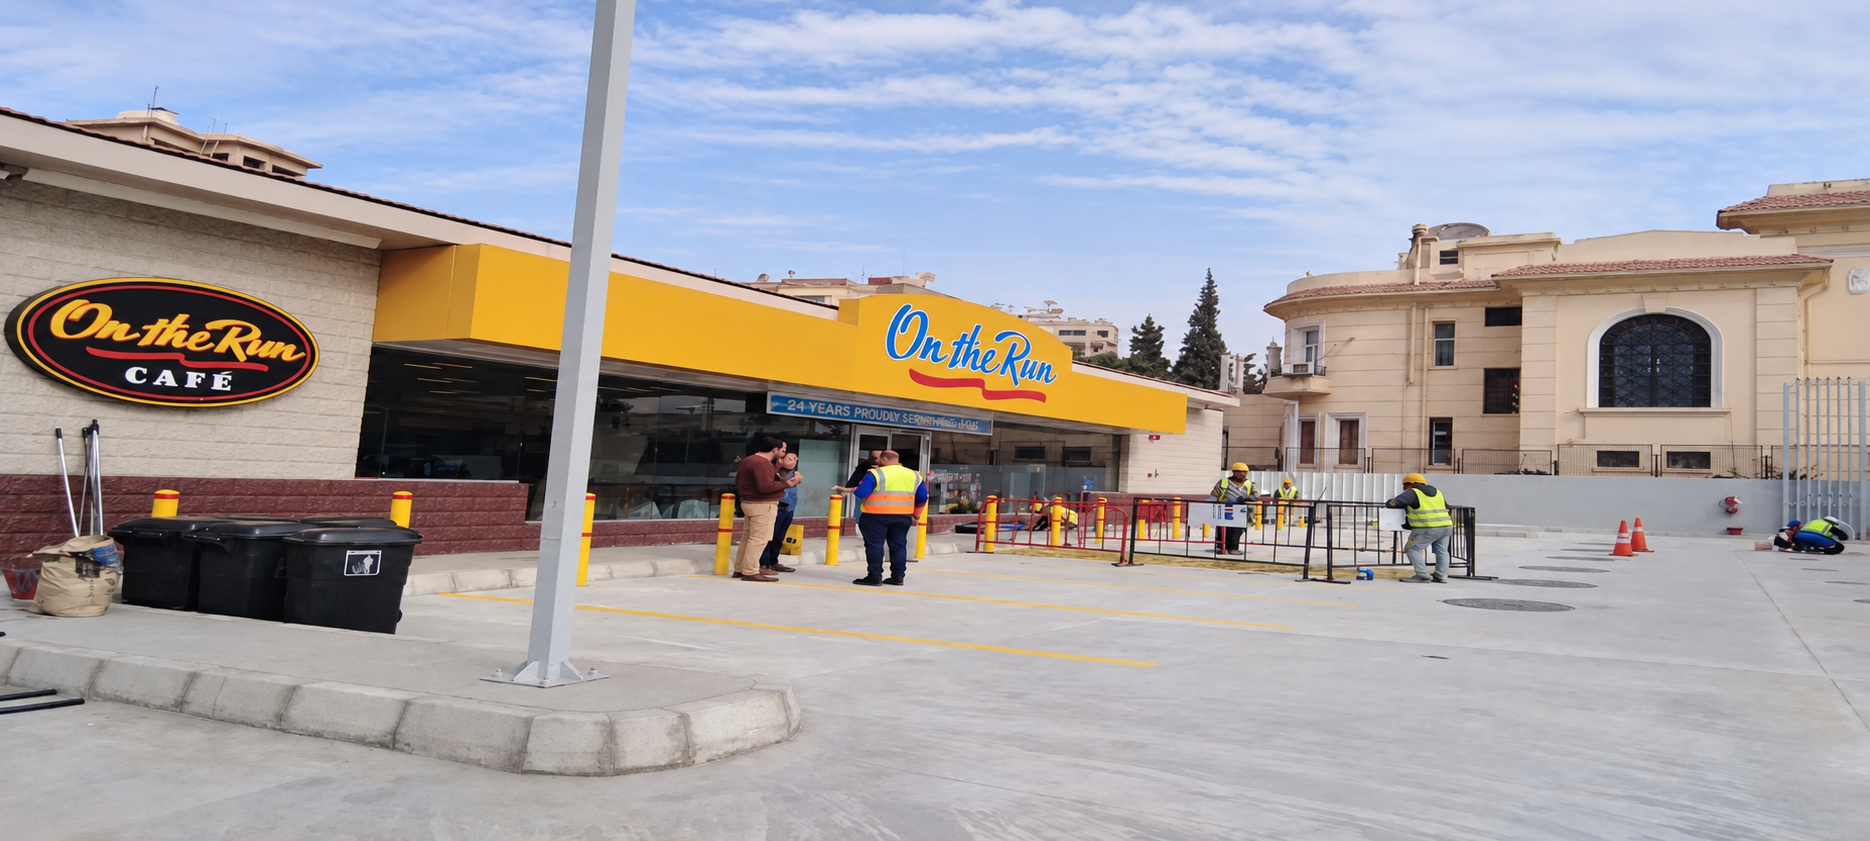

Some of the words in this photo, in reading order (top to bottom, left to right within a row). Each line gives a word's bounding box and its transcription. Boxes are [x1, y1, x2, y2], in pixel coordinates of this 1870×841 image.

[50, 298, 141, 342] On
[136, 313, 216, 351] the
[204, 318, 307, 363] Run
[885, 303, 949, 364] On
[947, 323, 1001, 375] the
[994, 330, 1058, 387] Run
[125, 366, 234, 392] CAFÉ
[787, 399, 805, 413] 24
[808, 401, 851, 417] YEARS
[853, 406, 902, 423] PROUDLY
